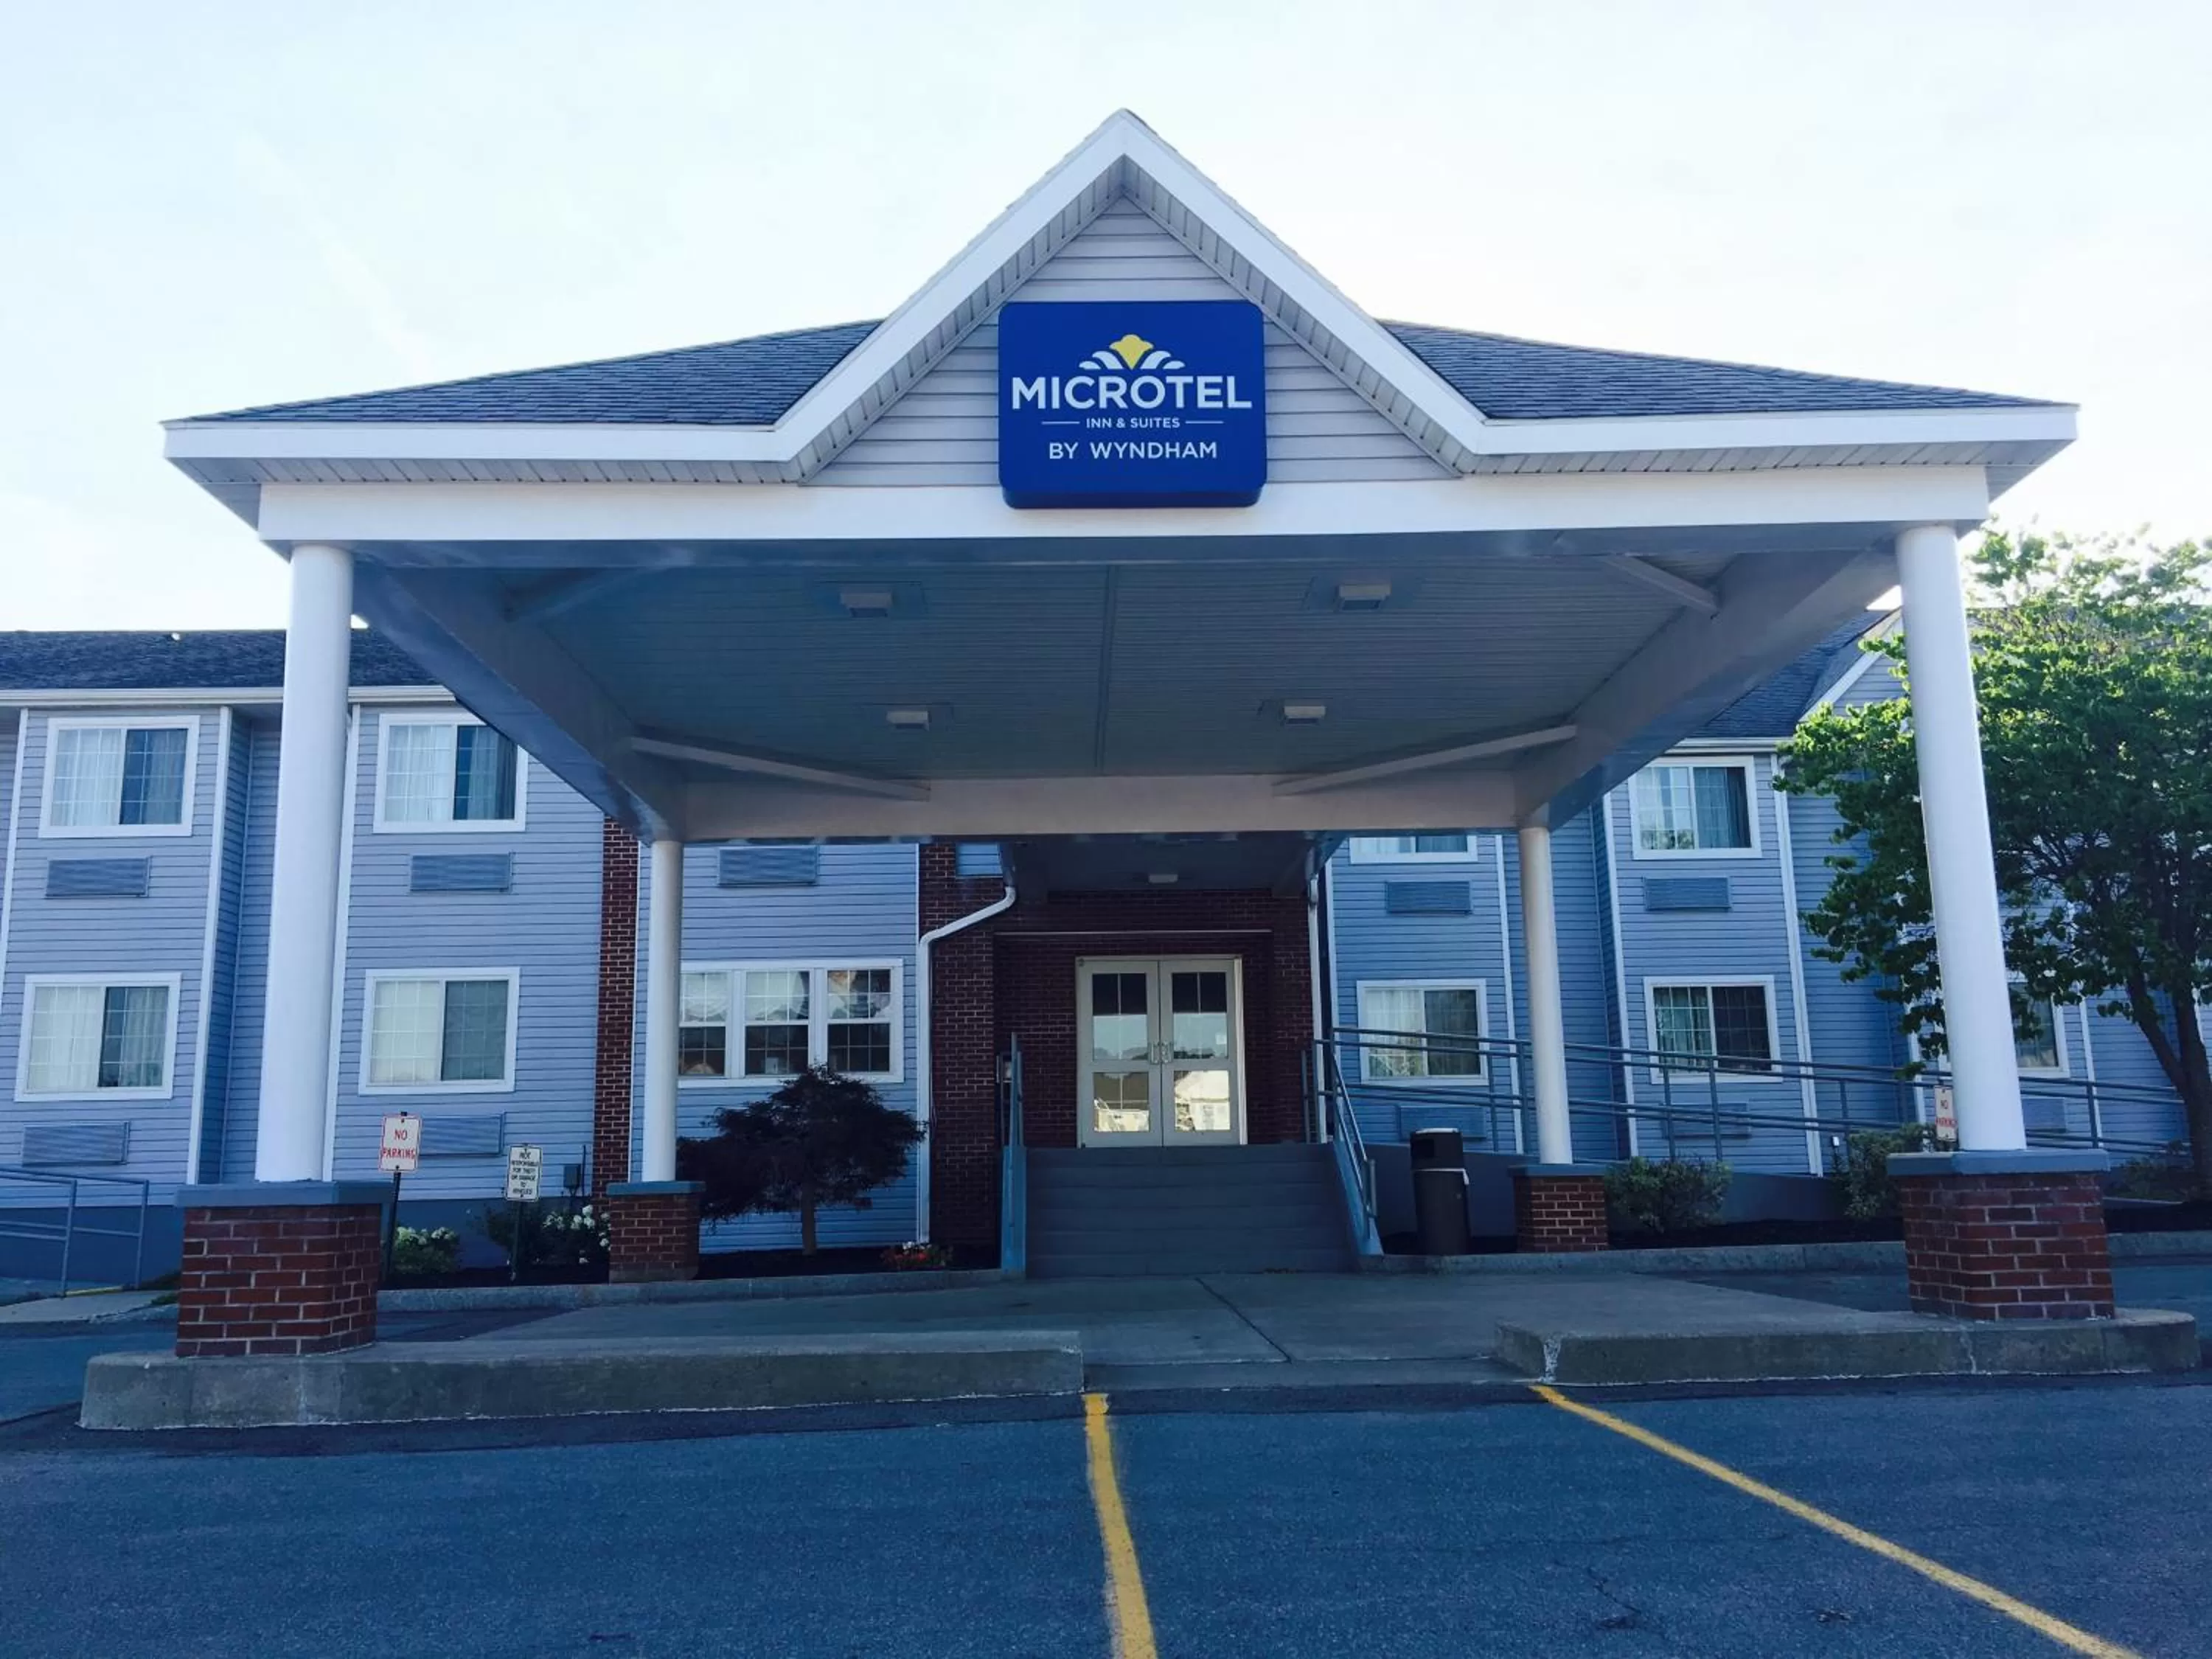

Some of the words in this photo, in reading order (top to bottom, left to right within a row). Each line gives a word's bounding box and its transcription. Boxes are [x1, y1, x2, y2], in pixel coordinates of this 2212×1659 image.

[1012, 375, 1252, 409] MICROTEL
[1086, 418, 1112, 428] INN
[1116, 418, 1126, 428] &
[1130, 417, 1180, 428] SUITES
[1049, 442, 1078, 459] BY
[1090, 442, 1217, 459] WYNDHAM
[394, 1129, 408, 1141] NO
[382, 1147, 416, 1160] PARKING
